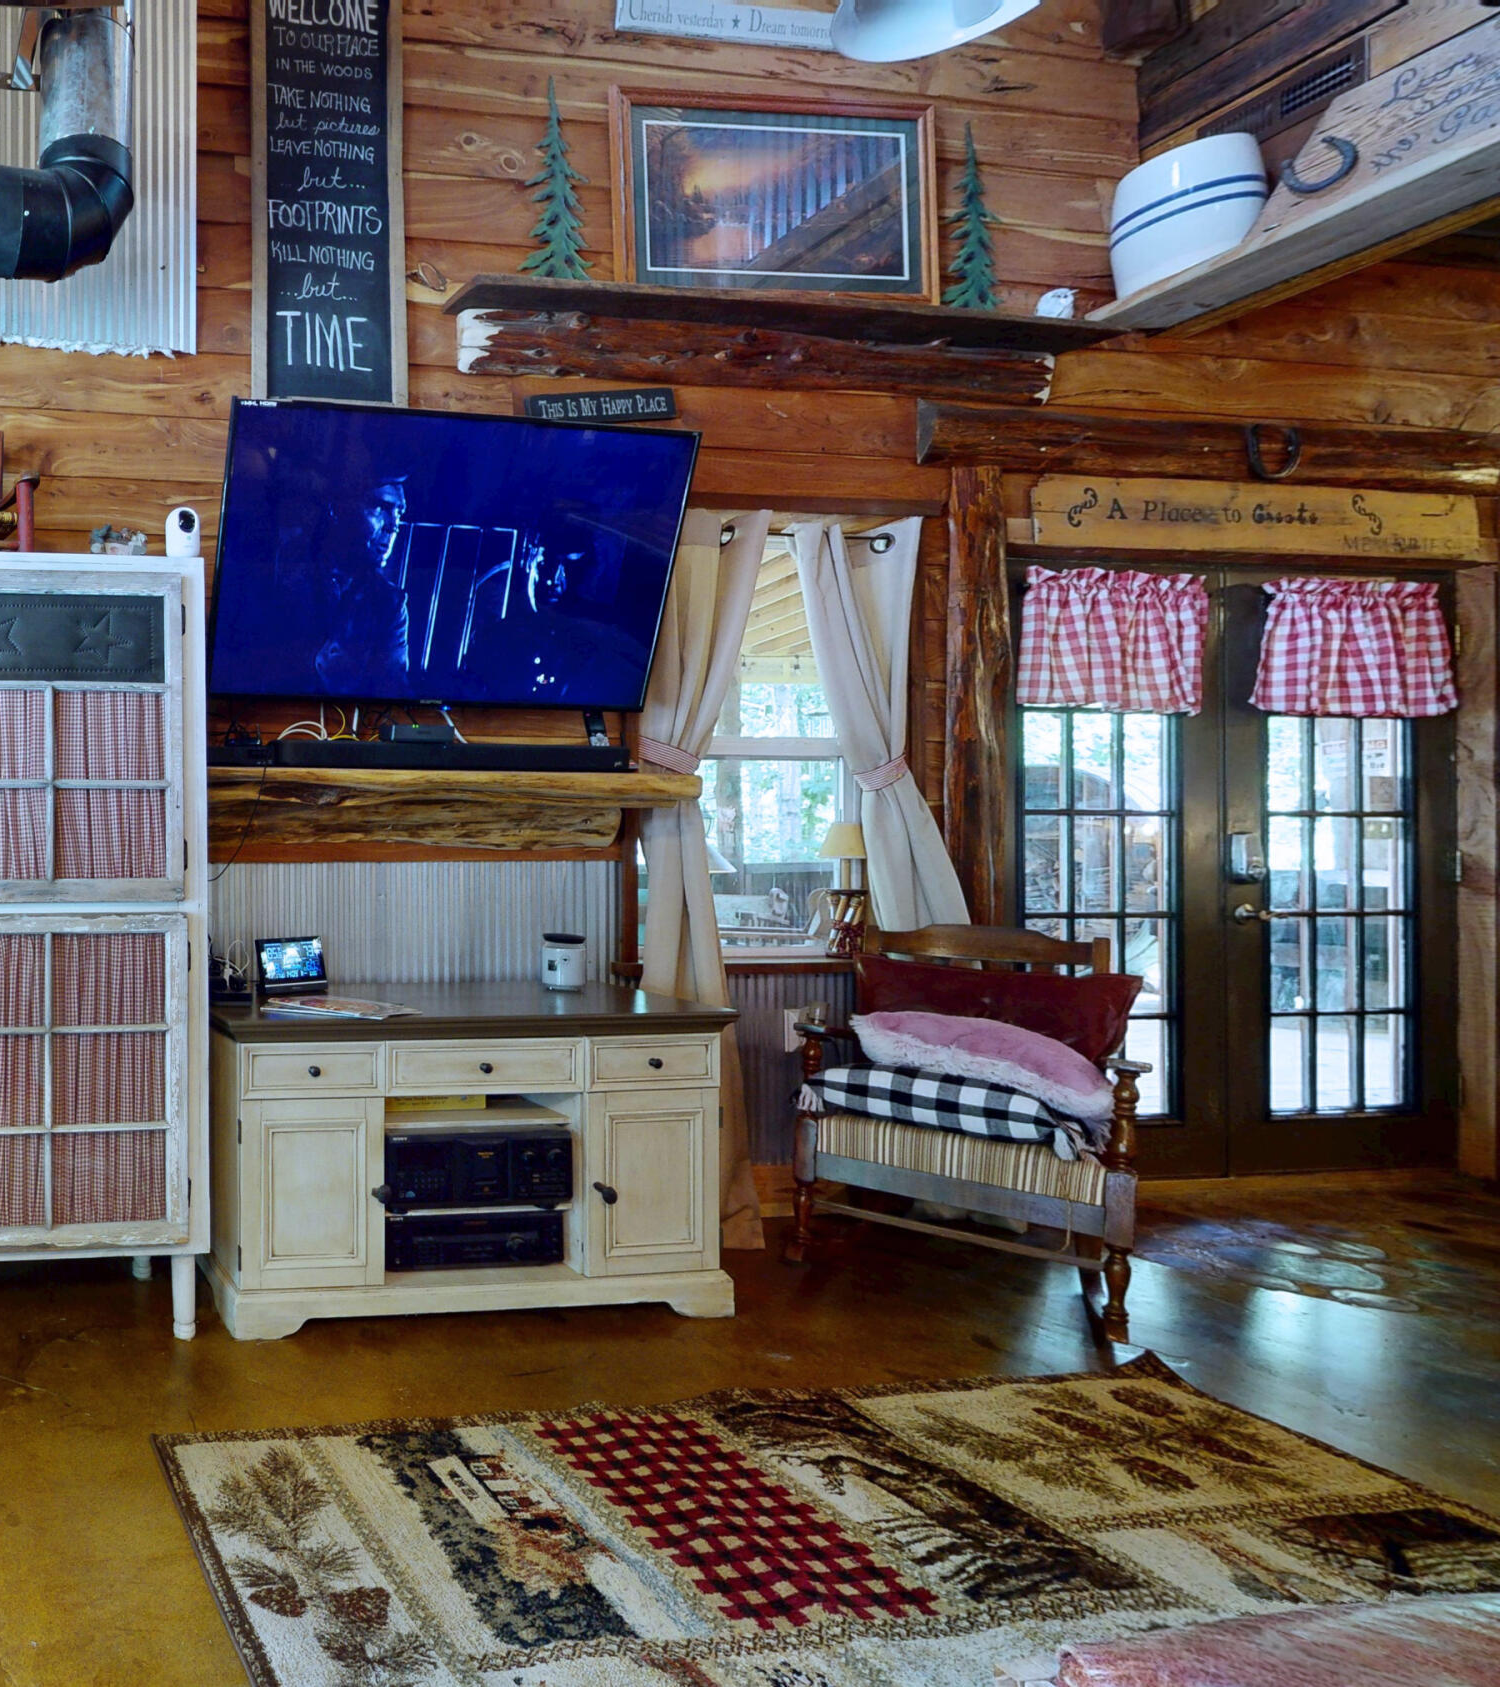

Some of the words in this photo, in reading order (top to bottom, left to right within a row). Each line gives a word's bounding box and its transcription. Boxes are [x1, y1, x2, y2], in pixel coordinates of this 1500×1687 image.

[269, 0, 379, 35] WELCOME
[629, 0, 673, 24] Cherish
[677, 4, 726, 28] yesterday
[748, 8, 786, 35] Dream
[791, 23, 831, 40] tomorro
[273, 26, 296, 46] TO
[299, 32, 335, 56] OUR
[337, 34, 380, 57] PLACE
[275, 58, 291, 71] IN
[293, 59, 316, 74] THE
[320, 62, 373, 80] WOODS
[267, 83, 307, 109] TAKE
[309, 90, 372, 114] NOTHING
[276, 112, 307, 131] but
[313, 116, 380, 136] pictures
[1432, 103, 1500, 144] Ga
[270, 136, 312, 157] LEAVE
[314, 139, 375, 165] NOTHING
[268, 199, 382, 235] FOOTPRINTS
[271, 240, 307, 263] KILL
[309, 245, 375, 272] NOTHING
[275, 310, 373, 373] TIME
[1106, 498, 1128, 520] A
[1141, 500, 1203, 523] Place
[1221, 504, 1242, 523] to
